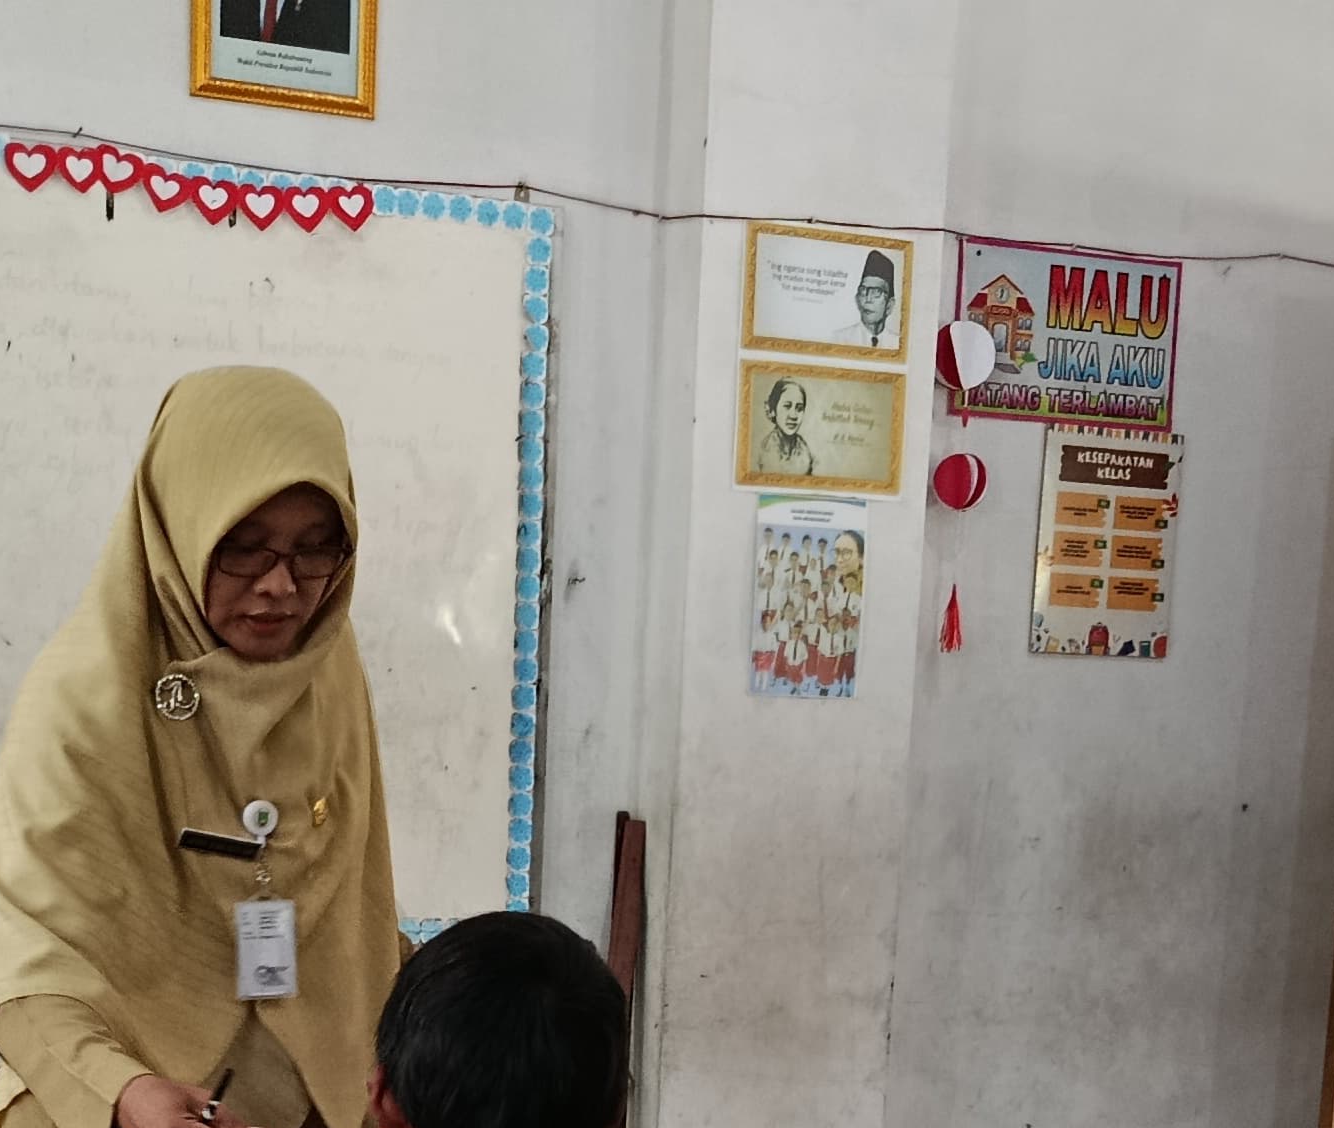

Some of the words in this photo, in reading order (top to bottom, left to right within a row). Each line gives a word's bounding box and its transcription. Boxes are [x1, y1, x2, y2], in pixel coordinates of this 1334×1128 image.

[1046, 264, 1171, 339] MALU
[1038, 337, 1102, 383] JIKA
[1107, 343, 1166, 389] AKU
[1046, 387, 1163, 421] TERLAMBAT
[1077, 451, 1155, 469] KESEPAKATAN
[1097, 467, 1132, 481] KELAS
